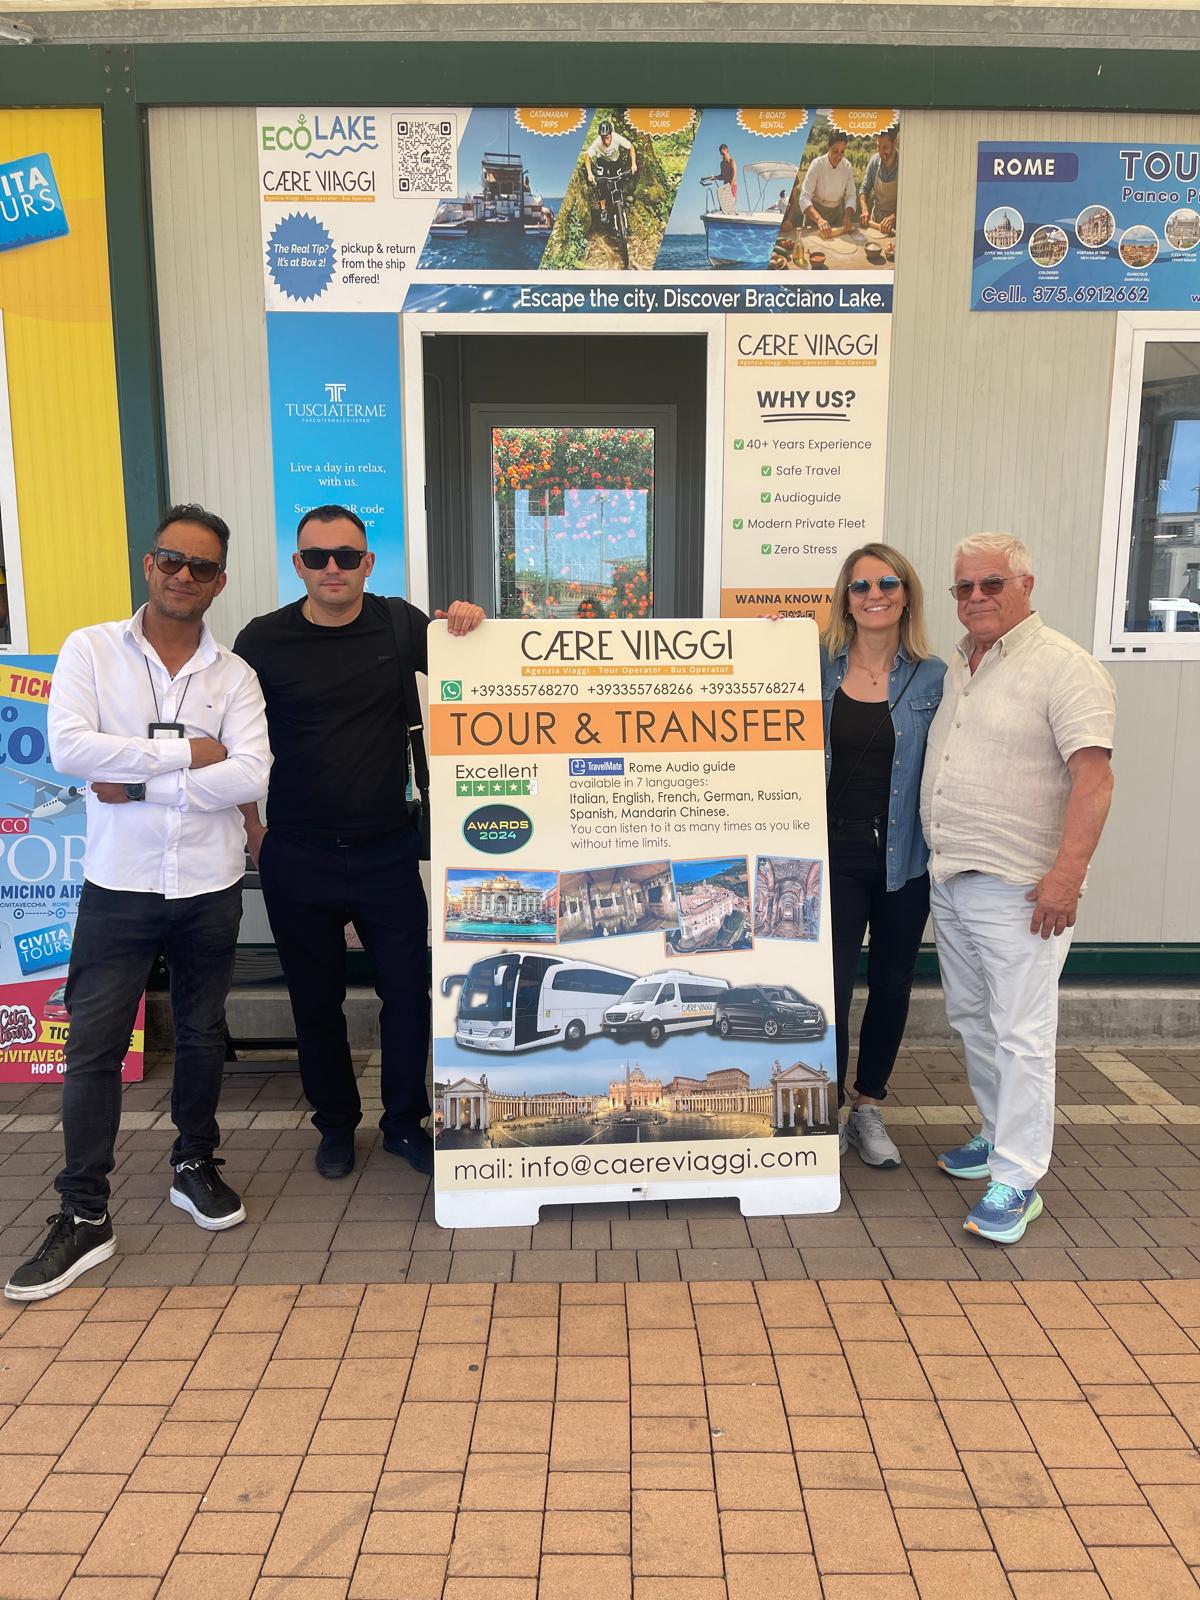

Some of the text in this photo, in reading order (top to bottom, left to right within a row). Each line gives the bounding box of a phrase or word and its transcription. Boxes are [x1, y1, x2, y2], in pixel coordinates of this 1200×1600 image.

[529, 111, 569, 119] CATAMARAN
[649, 110, 670, 118] E-BIKE
[758, 111, 786, 119] E-BOATS
[848, 111, 878, 119] COOKING
[540, 120, 559, 128] TRIPS
[649, 120, 671, 128] TOURS
[760, 121, 784, 129] RENTAL
[849, 121, 877, 129] CLASSES
[262, 115, 376, 151] ECO LAKE
[993, 158, 1055, 176] ROME
[315, 170, 375, 192] VIAGGI
[1121, 187, 1180, 203] Panco
[273, 243, 329, 256] The Real Tip?
[341, 243, 416, 256] pickup & return
[277, 258, 326, 267] It's at Box 2!
[342, 258, 406, 271] from the ship
[342, 273, 380, 284] offered!
[520, 288, 885, 312] Escape the city. Discover Bracciano Lake.
[981, 285, 1149, 303] Cell. 375.6912662
[804, 333, 878, 356] VIAGGI
[756, 389, 856, 408] WHY US?
[285, 403, 387, 417] TUSCIATERME
[746, 439, 872, 452] 40+ Years Experience
[289, 462, 386, 475] Live a day in relax,
[776, 465, 841, 476] Safe Travel
[318, 476, 358, 487] with us.
[773, 492, 842, 505] Audioguide
[360, 504, 385, 514] code
[747, 518, 866, 529] Modern Private Fleet
[774, 544, 838, 555] Zero Stress
[735, 594, 782, 604] WANNA
[784, 594, 823, 604] KNOW
[620, 629, 733, 660] VIAGGI
[525, 665, 729, 676] Agenzia Viaggi Tour Operator Bus Operator
[470, 682, 805, 697] +393355768270 +393355768266 +393355768274
[450, 708, 806, 746] TOUR & TRANSFER
[455, 763, 538, 779] Excellent
[587, 761, 623, 771] TravelMate
[629, 760, 736, 774] Rome Audio guide
[569, 777, 709, 790] available in 7 languages:
[569, 789, 802, 806] Italian, English, French, German, Russian,
[569, 806, 730, 821] Spanish, Mandarin Chinese.
[466, 820, 529, 831] AWARDS
[570, 820, 810, 834] You can listen to it as many times as you like
[479, 831, 517, 840] 2024
[570, 837, 671, 849] without time limits.
[19, 928, 68, 950] CIVITA
[21, 938, 72, 963] TOURS
[31, 1063, 54, 1074] HOP
[454, 1148, 818, 1181] mail: info@caereviaggi.com
